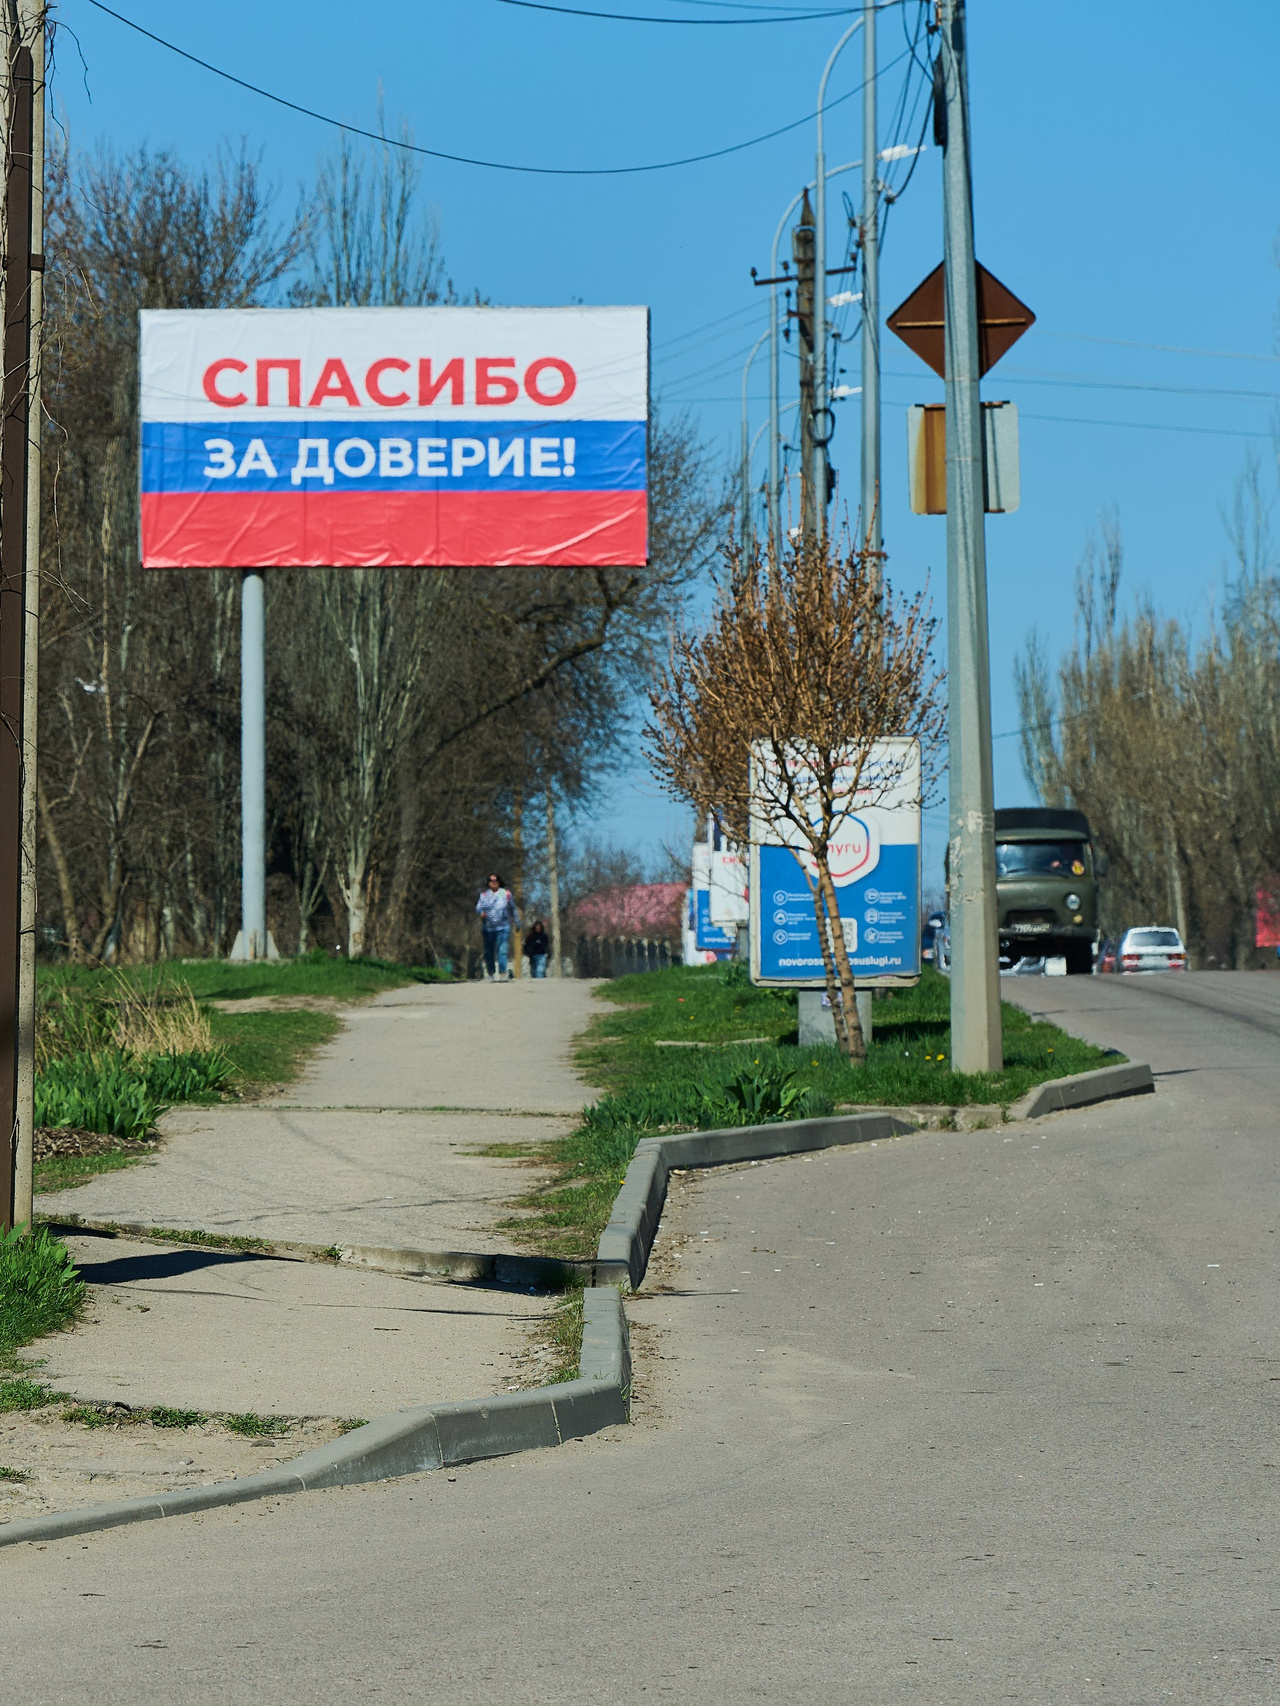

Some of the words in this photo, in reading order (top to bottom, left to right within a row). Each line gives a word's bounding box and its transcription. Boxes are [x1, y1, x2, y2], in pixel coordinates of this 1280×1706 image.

[202, 357, 577, 407] СПАСИБО
[203, 438, 278, 478] ЗА
[290, 437, 577, 485] ДОВЕРИЕ!
[808, 843, 861, 857] луги
